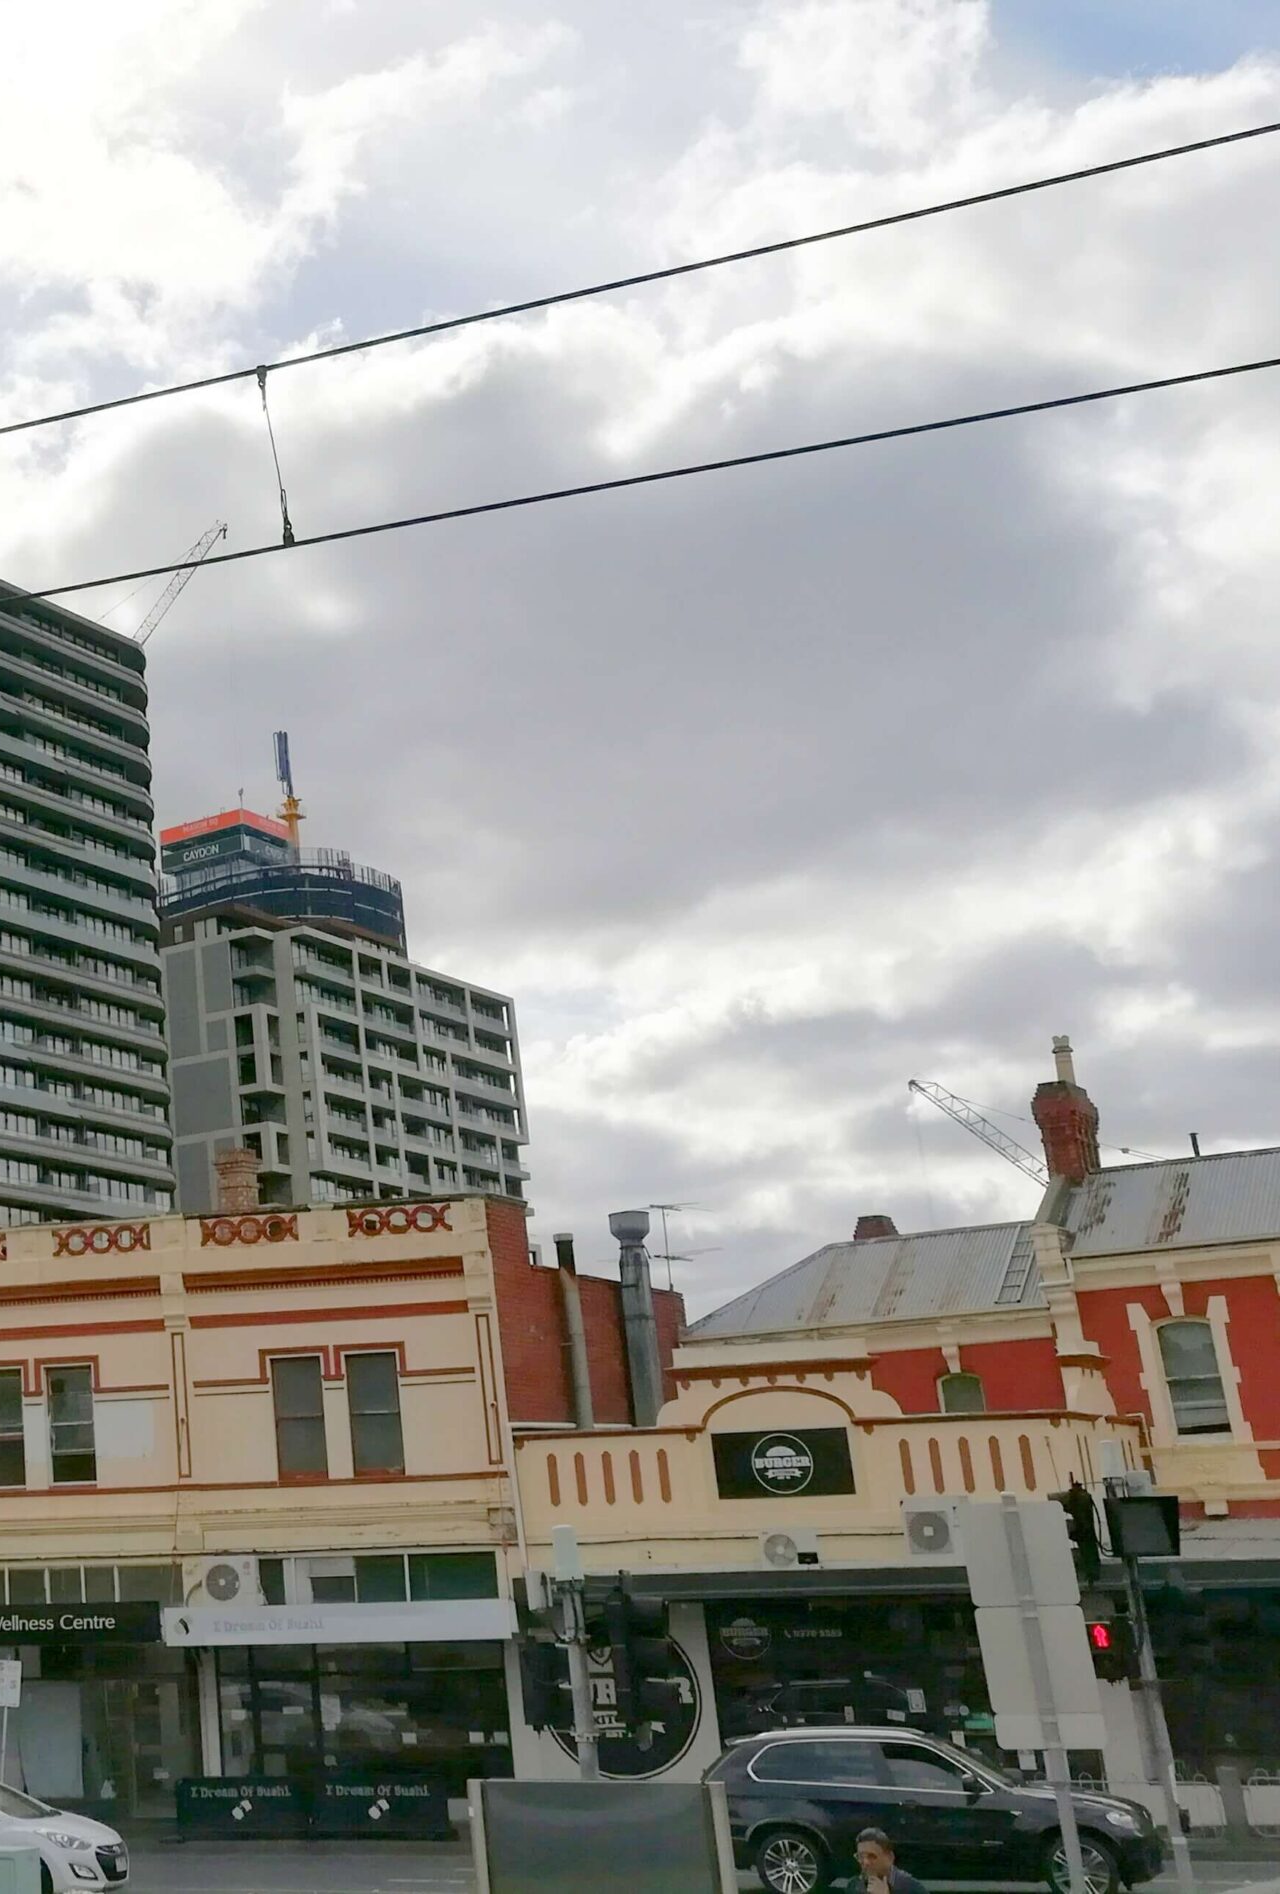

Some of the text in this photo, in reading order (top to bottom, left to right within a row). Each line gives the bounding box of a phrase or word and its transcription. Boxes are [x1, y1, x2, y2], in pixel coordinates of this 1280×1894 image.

[183, 844, 219, 862] CAYDON
[754, 1456, 811, 1469] BURGER
[59, 1614, 116, 1630] Centre
[224, 1619, 265, 1633] Dream
[287, 1616, 325, 1630] Sushi
[201, 1787, 239, 1798] Dream
[240, 1786, 253, 1797] Of
[336, 1785, 375, 1797] Dream
[377, 1785, 392, 1797] Of
